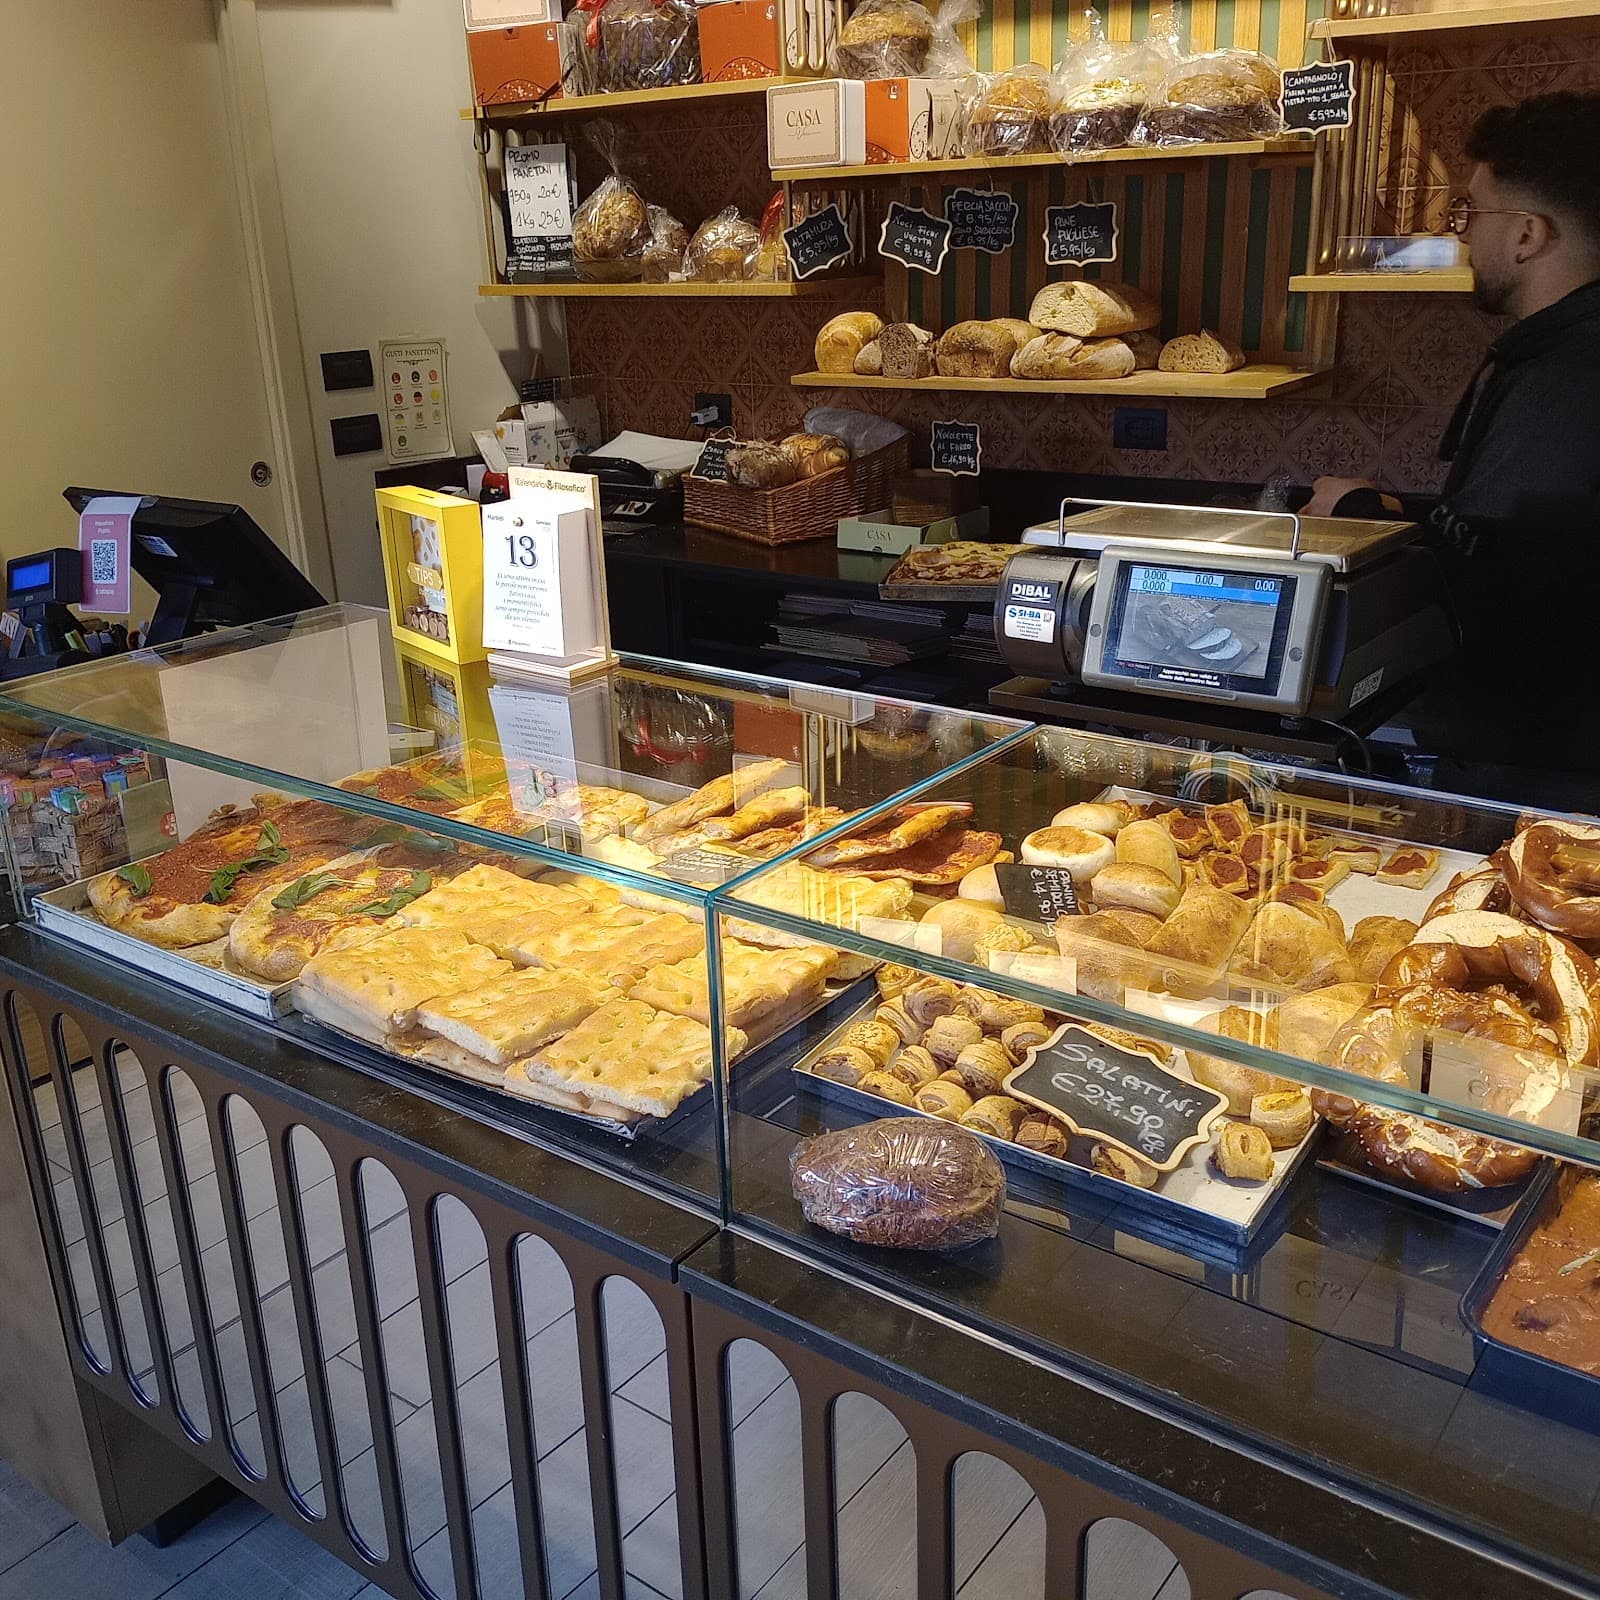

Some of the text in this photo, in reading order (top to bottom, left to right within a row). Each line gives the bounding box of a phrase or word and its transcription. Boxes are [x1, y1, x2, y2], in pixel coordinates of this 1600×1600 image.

[786, 108, 822, 127] CASA
[405, 348, 439, 357] PANETTONI
[514, 478, 545, 488] Calendario
[866, 529, 892, 541] CASA
[504, 535, 537, 568] 13
[414, 566, 434, 586] TIPS
[1011, 583, 1051, 599] DIBAL
[1018, 609, 1041, 619] SI-BA
[1058, 870, 1077, 909] PANINI
